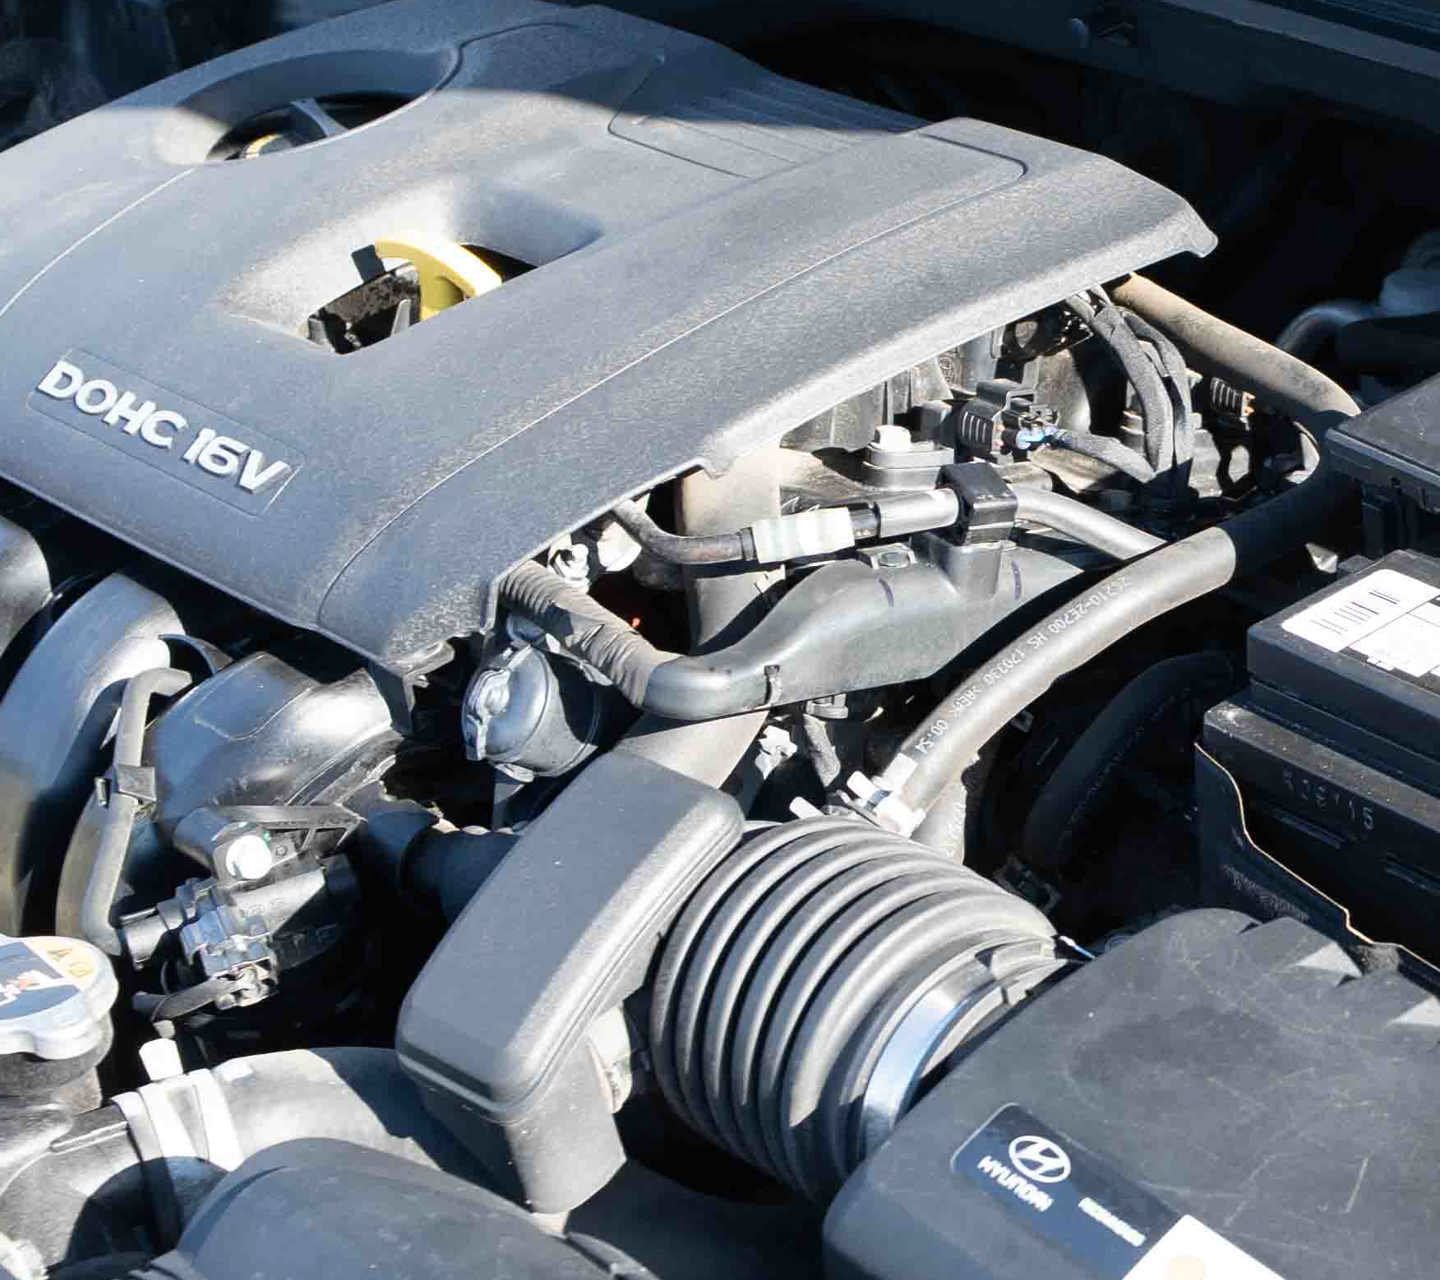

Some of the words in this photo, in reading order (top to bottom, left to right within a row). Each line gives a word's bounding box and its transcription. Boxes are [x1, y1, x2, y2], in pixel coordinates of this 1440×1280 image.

[36, 360, 189, 449] DOHC
[182, 427, 291, 495] 16V
[977, 1155, 1055, 1213] HYUNDAI
